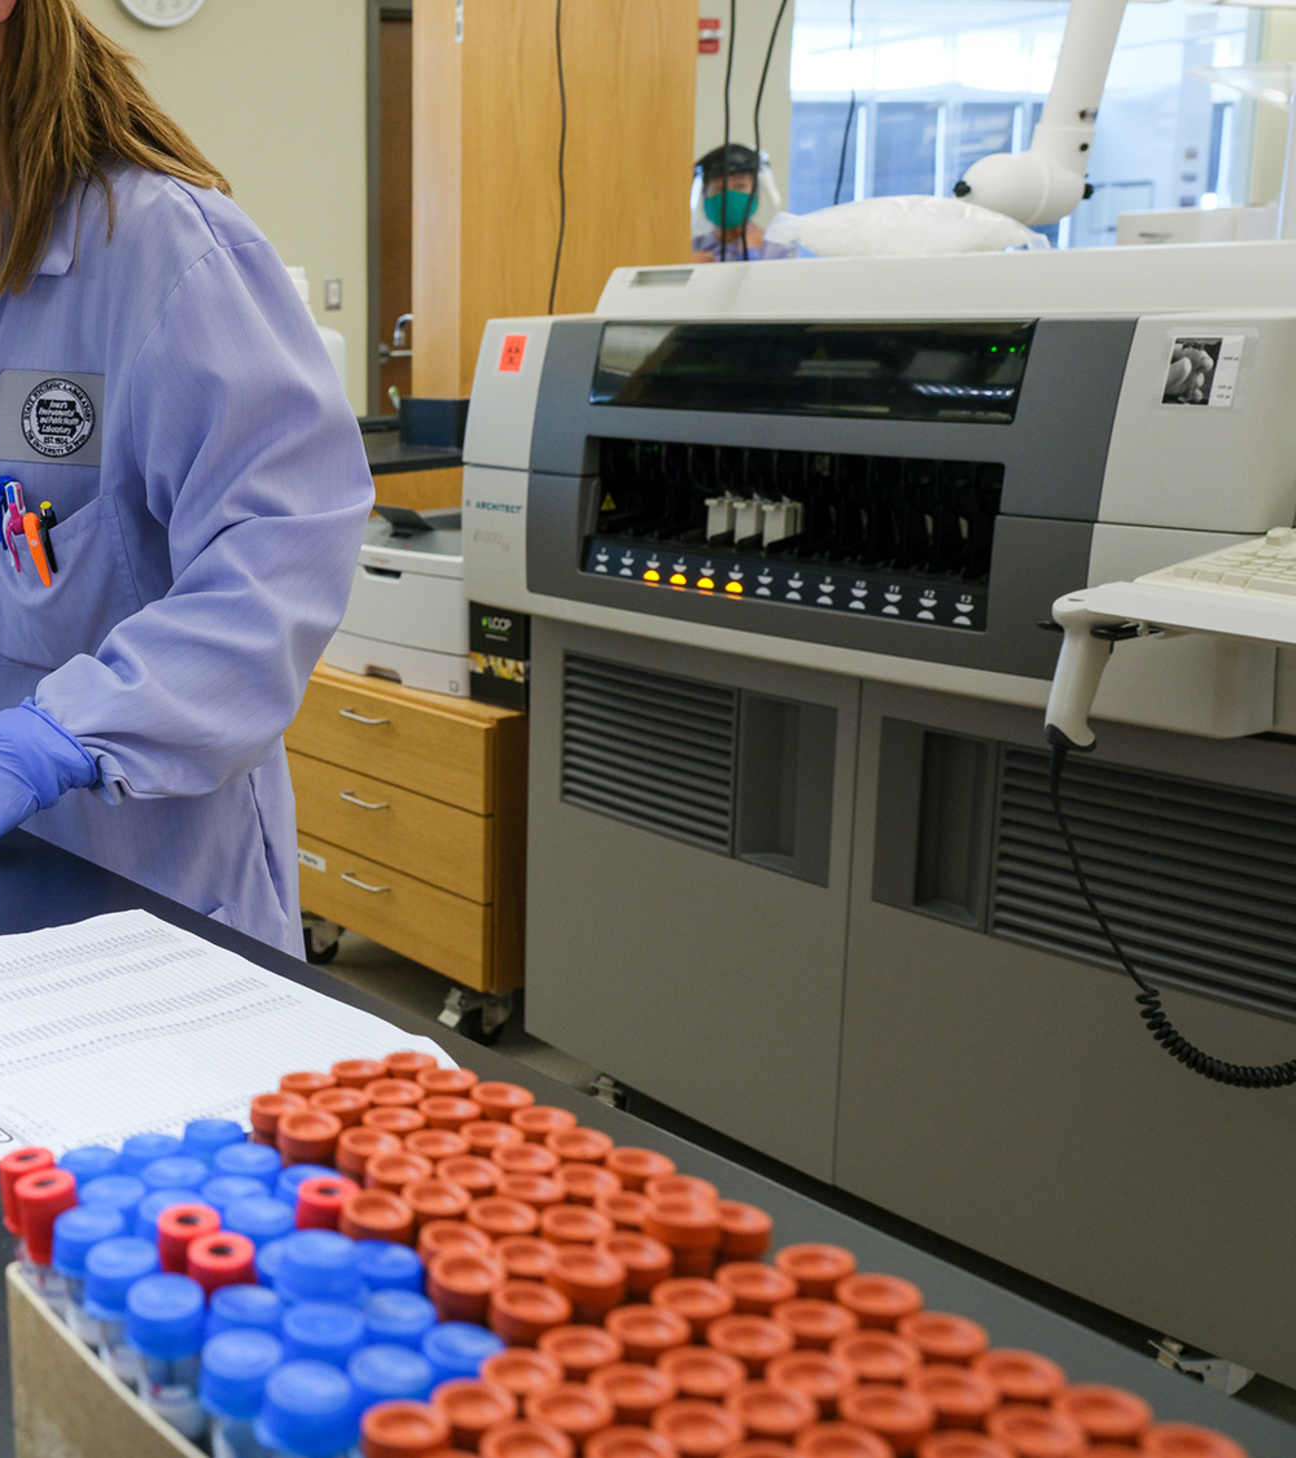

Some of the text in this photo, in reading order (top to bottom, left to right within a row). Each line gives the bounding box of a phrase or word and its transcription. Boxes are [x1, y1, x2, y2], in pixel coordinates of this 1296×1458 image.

[855, 580, 867, 588] 10
[889, 585, 900, 593] 11
[924, 589, 935, 598] 12
[960, 594, 972, 603] 13
